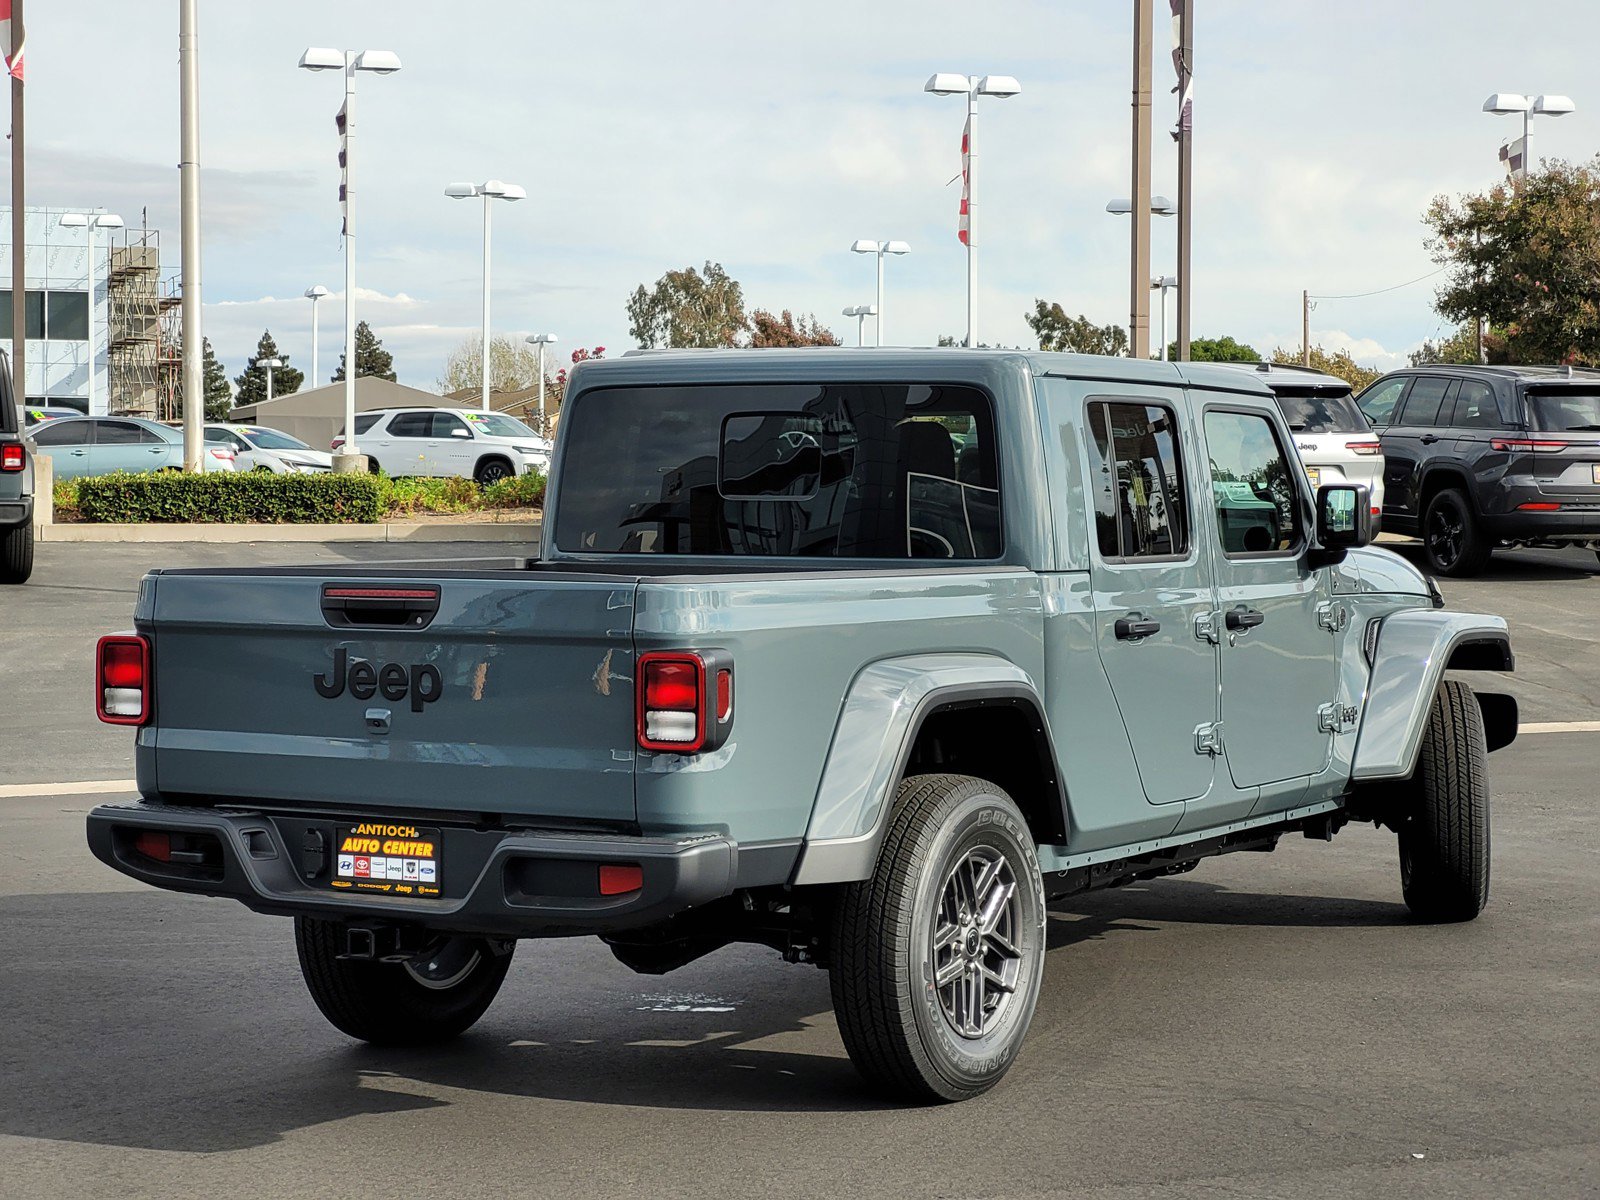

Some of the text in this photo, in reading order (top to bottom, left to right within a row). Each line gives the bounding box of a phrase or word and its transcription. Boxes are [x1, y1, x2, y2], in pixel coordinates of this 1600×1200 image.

[1298, 442, 1318, 451] Jeep
[313, 647, 443, 713] Jeep
[356, 823, 415, 838] ANTIOCH
[340, 837, 434, 858] AUTO CENTER
[395, 884, 413, 894] Jeep
